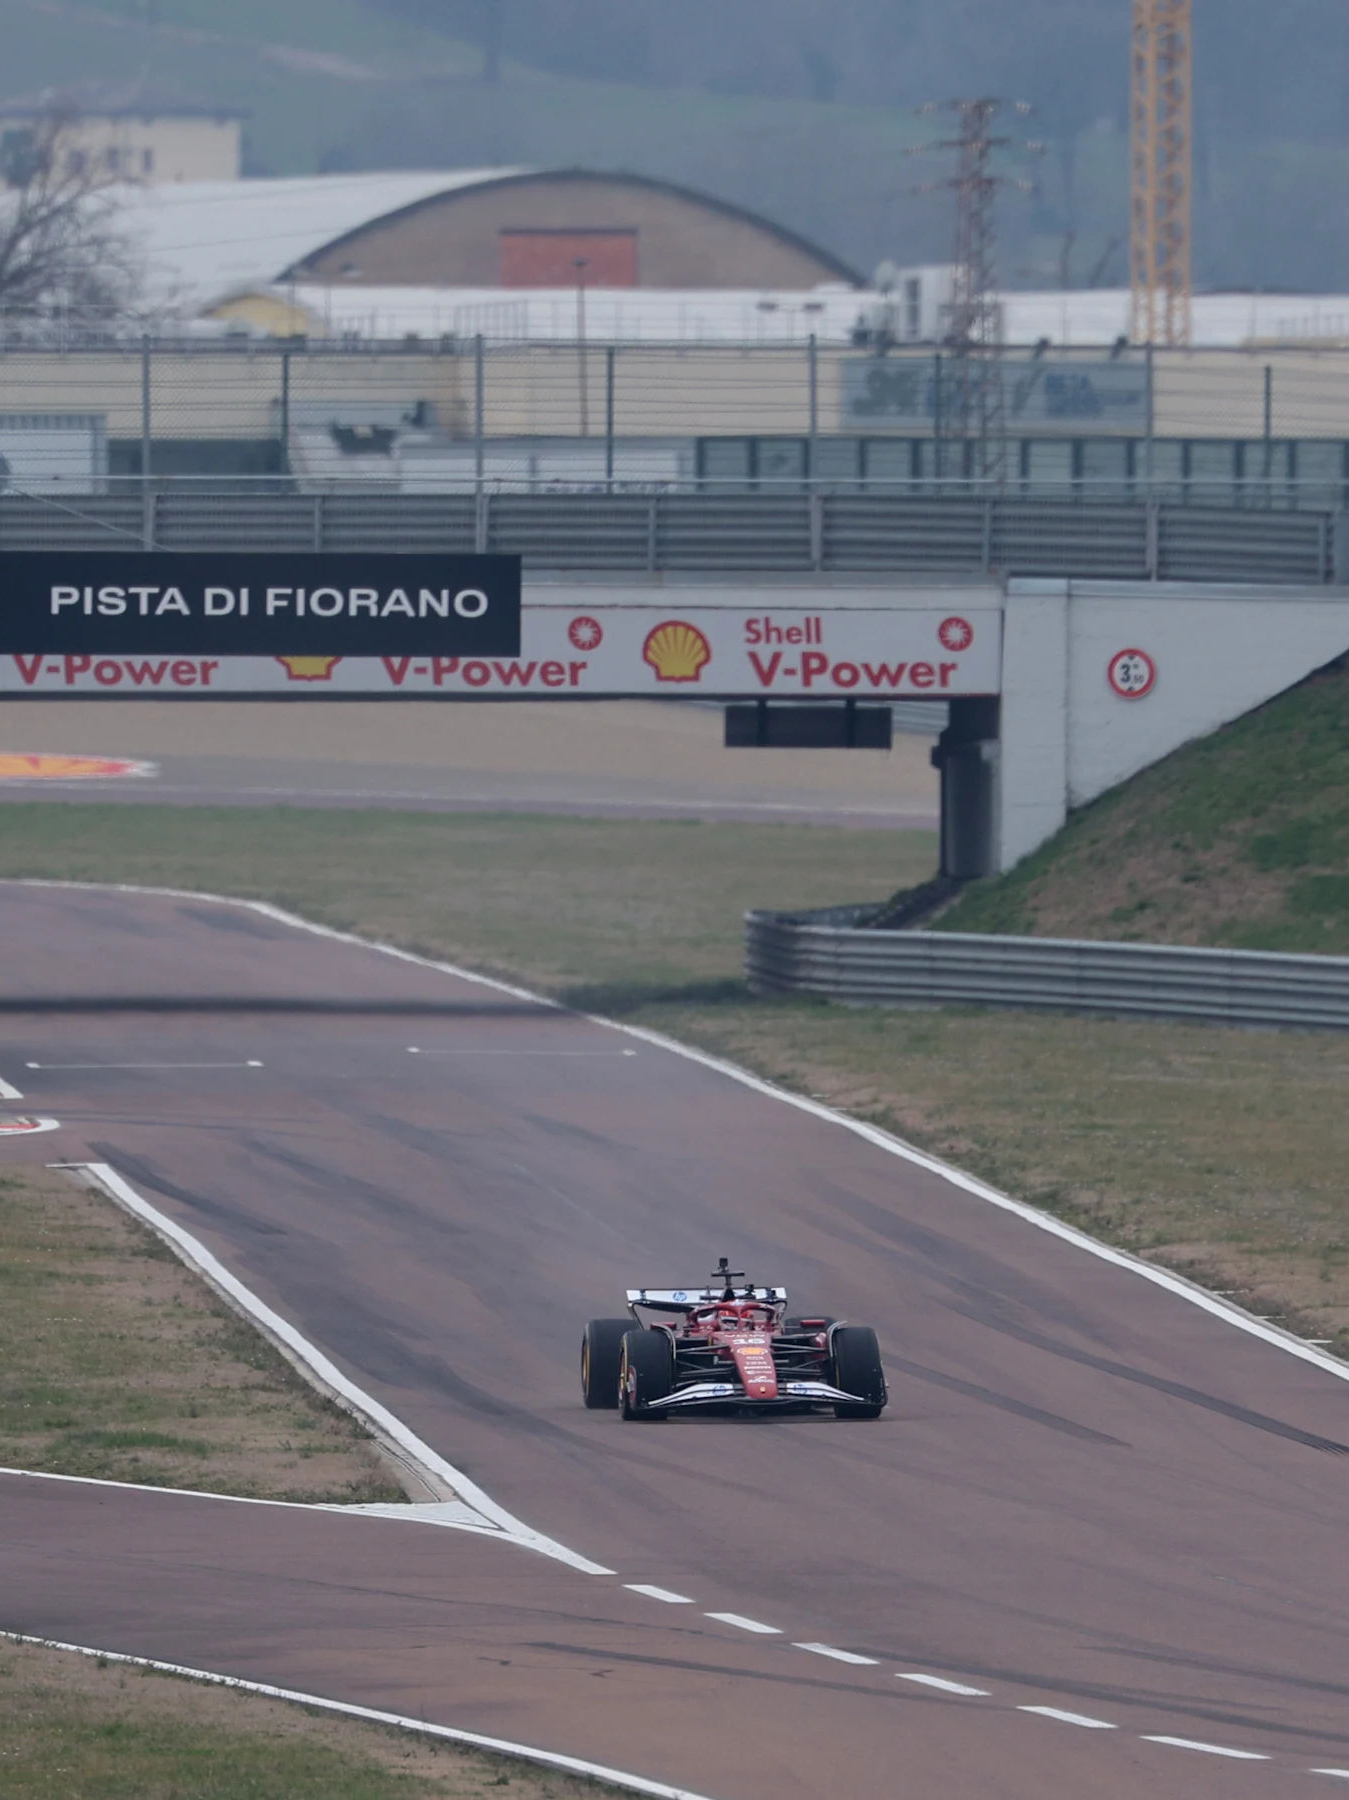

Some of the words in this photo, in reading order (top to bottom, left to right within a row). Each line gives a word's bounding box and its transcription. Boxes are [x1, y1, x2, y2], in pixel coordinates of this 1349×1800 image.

[51, 586, 191, 616] PISTA
[204, 587, 249, 616] DI
[266, 588, 488, 618] FIORANO
[745, 616, 821, 644] Shell
[13, 655, 218, 686] V-Power
[381, 657, 587, 687] V-Power
[748, 651, 958, 688] V-Power
